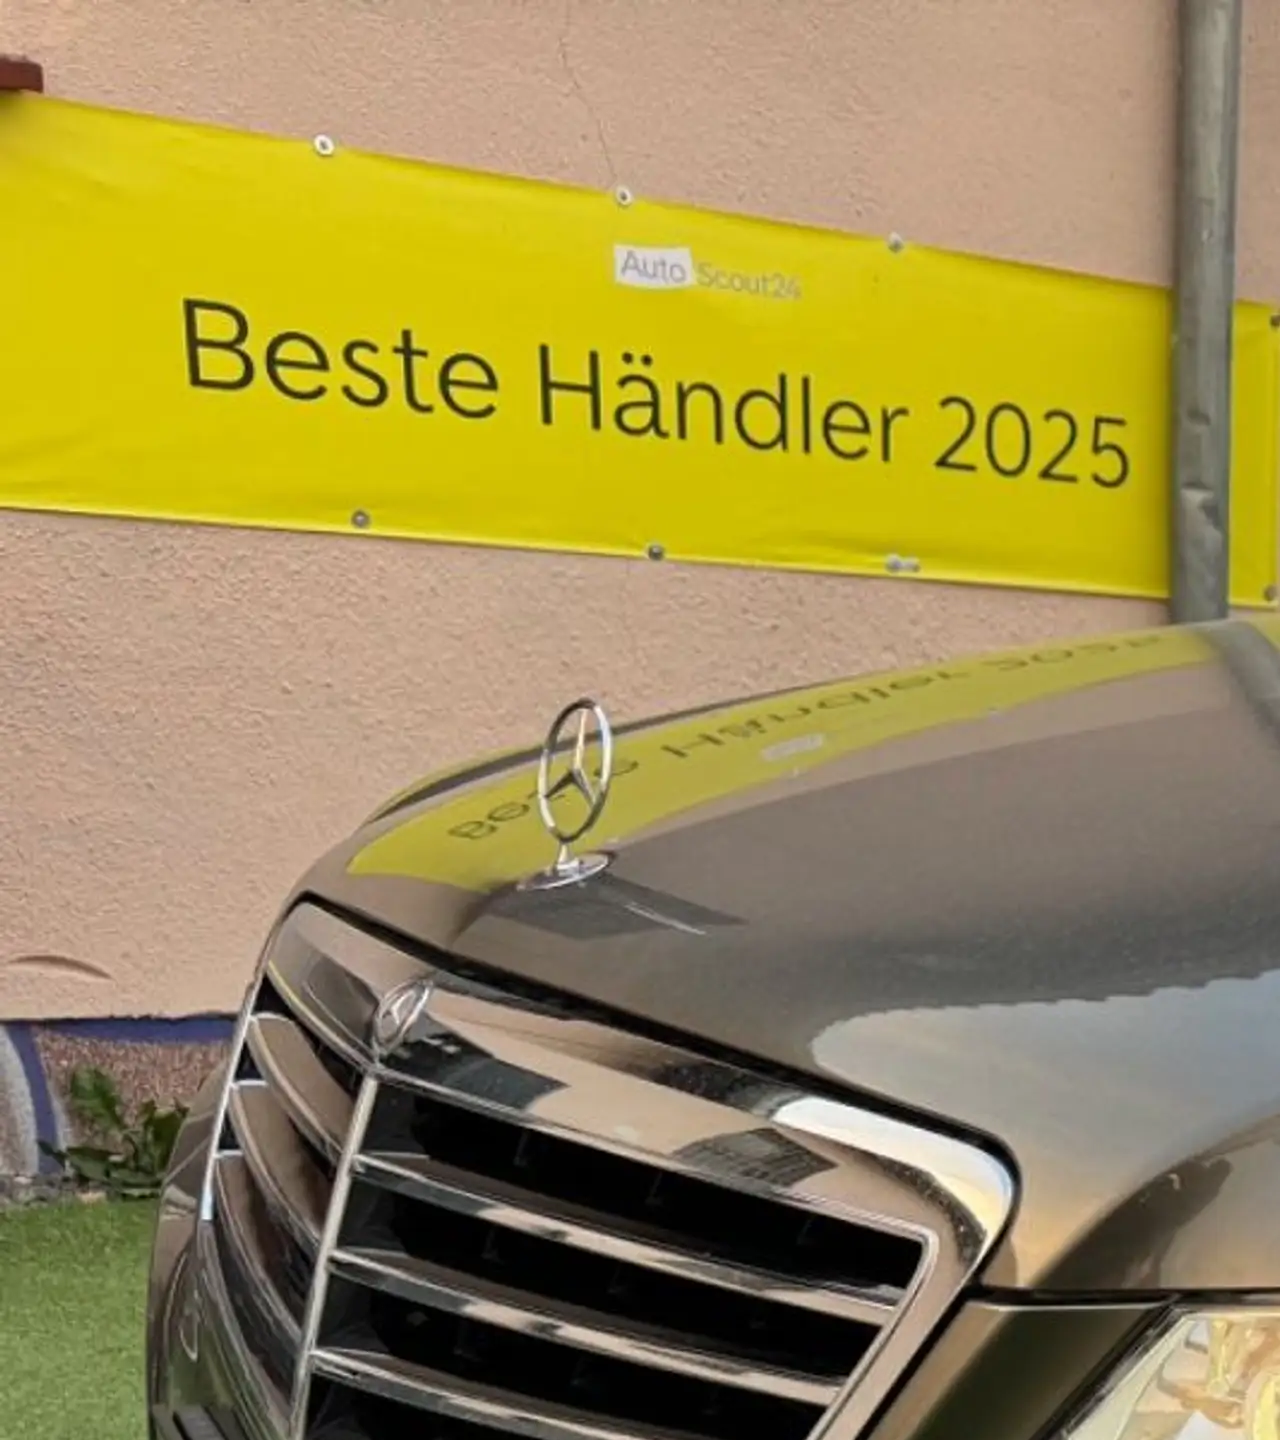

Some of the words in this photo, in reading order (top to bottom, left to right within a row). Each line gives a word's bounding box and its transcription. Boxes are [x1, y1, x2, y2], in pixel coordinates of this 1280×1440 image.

[182, 297, 499, 420] Beste
[538, 343, 910, 464] Händler
[934, 395, 1130, 490] 2025
